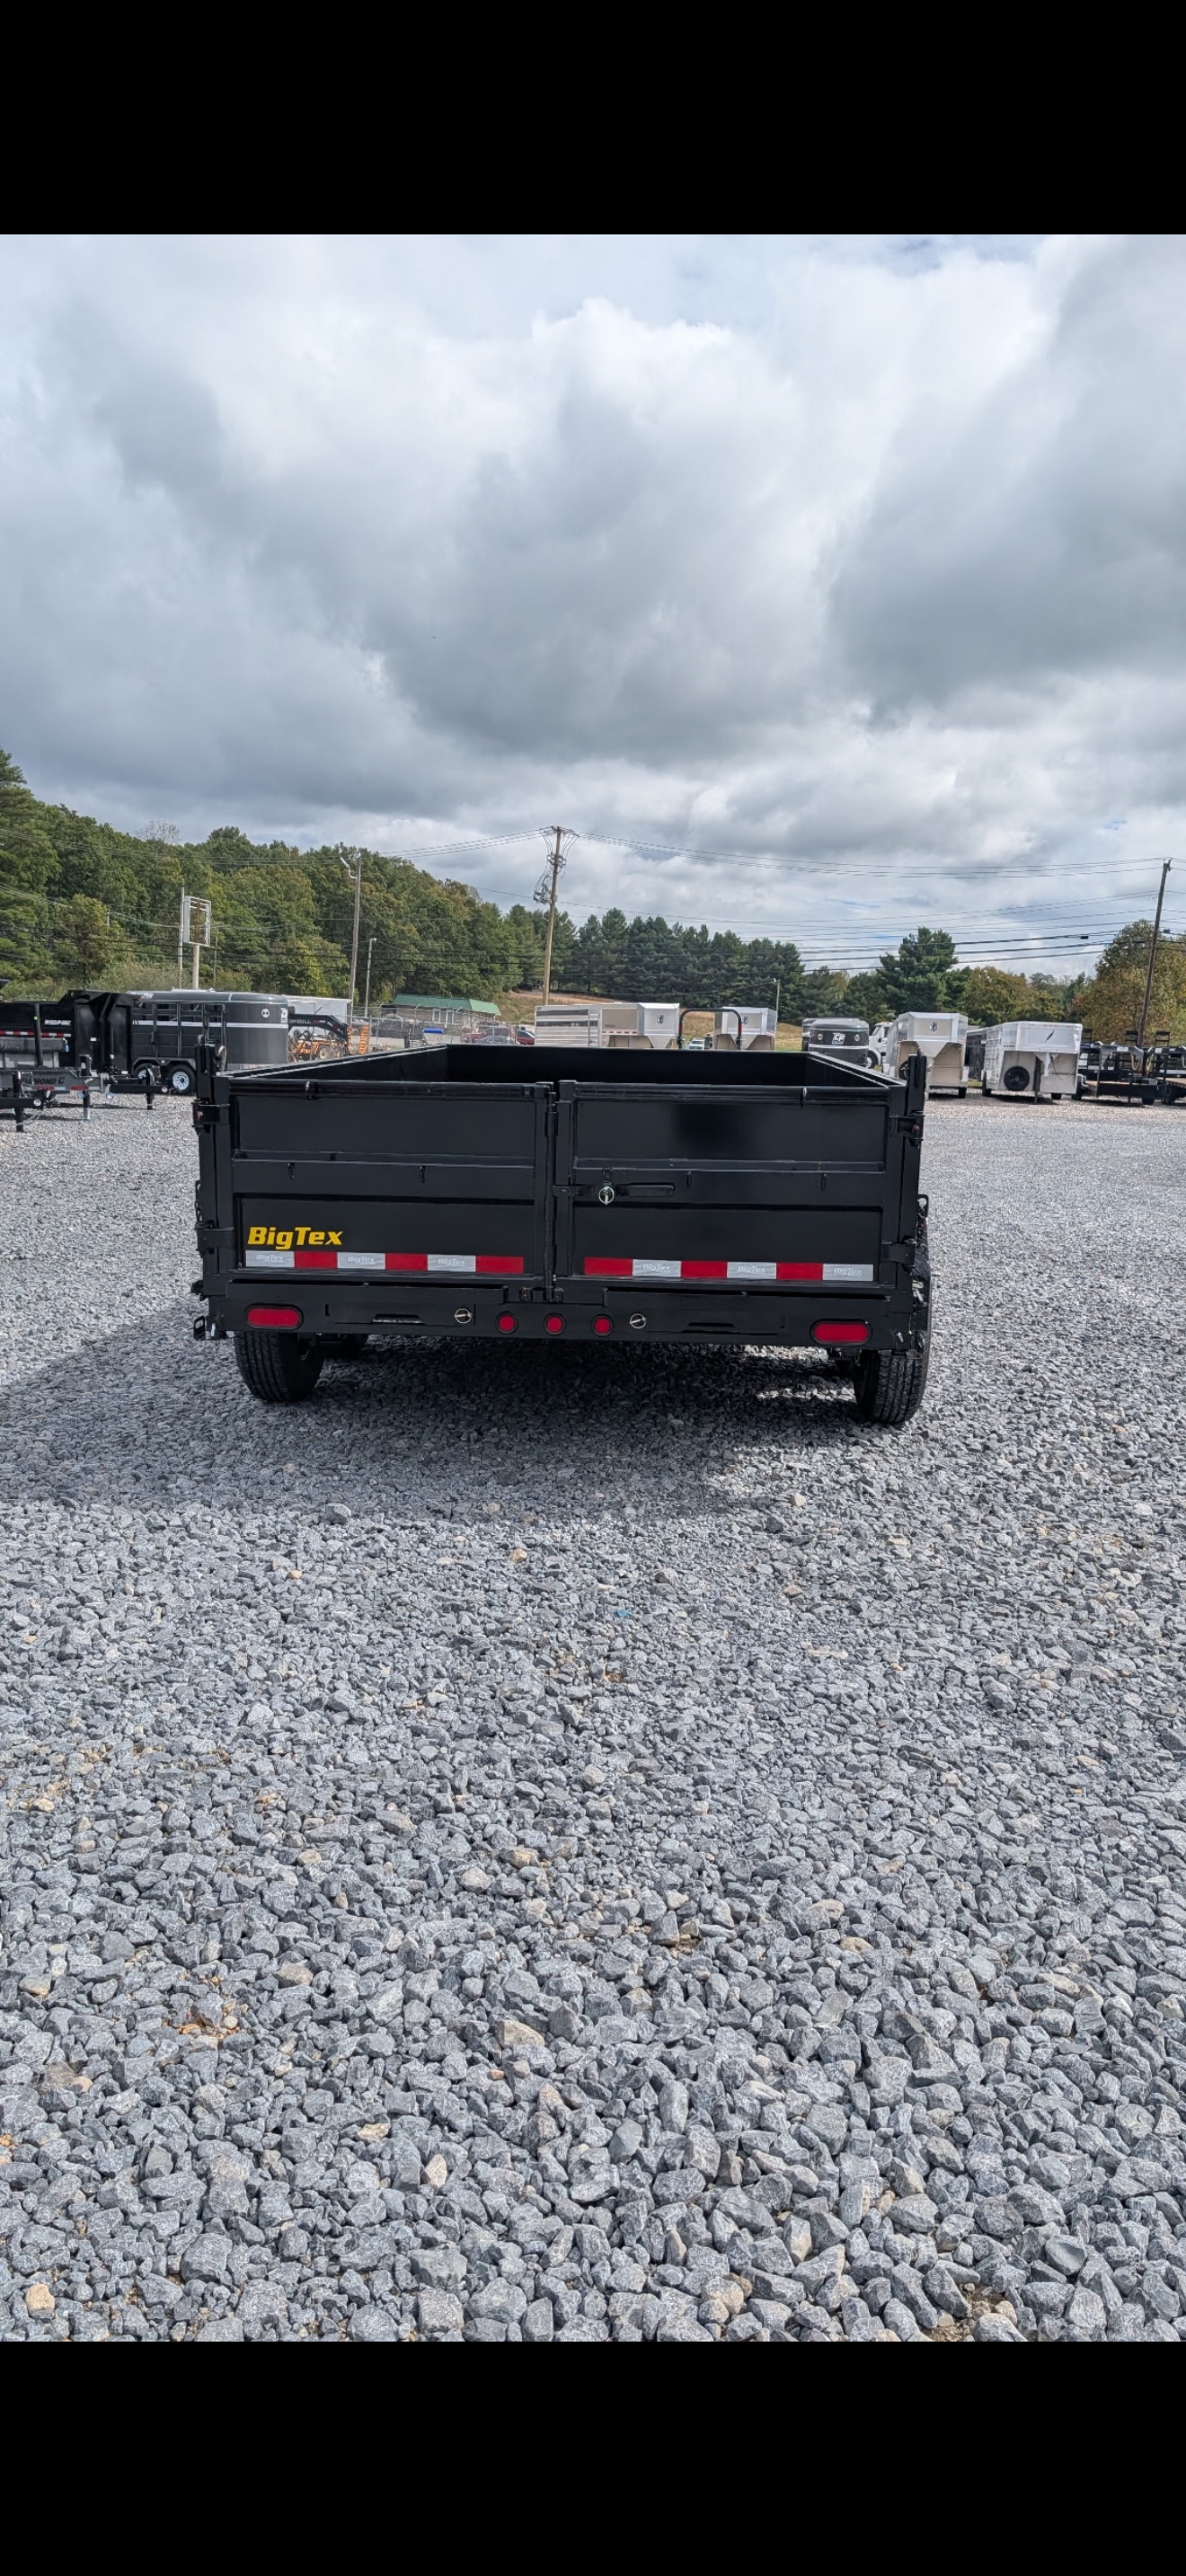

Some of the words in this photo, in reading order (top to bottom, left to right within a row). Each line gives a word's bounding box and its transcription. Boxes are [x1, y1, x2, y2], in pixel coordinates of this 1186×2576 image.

[58, 1076, 66, 1085] C
[247, 1226, 343, 1250] BigTex
[255, 1254, 284, 1262] BigTex
